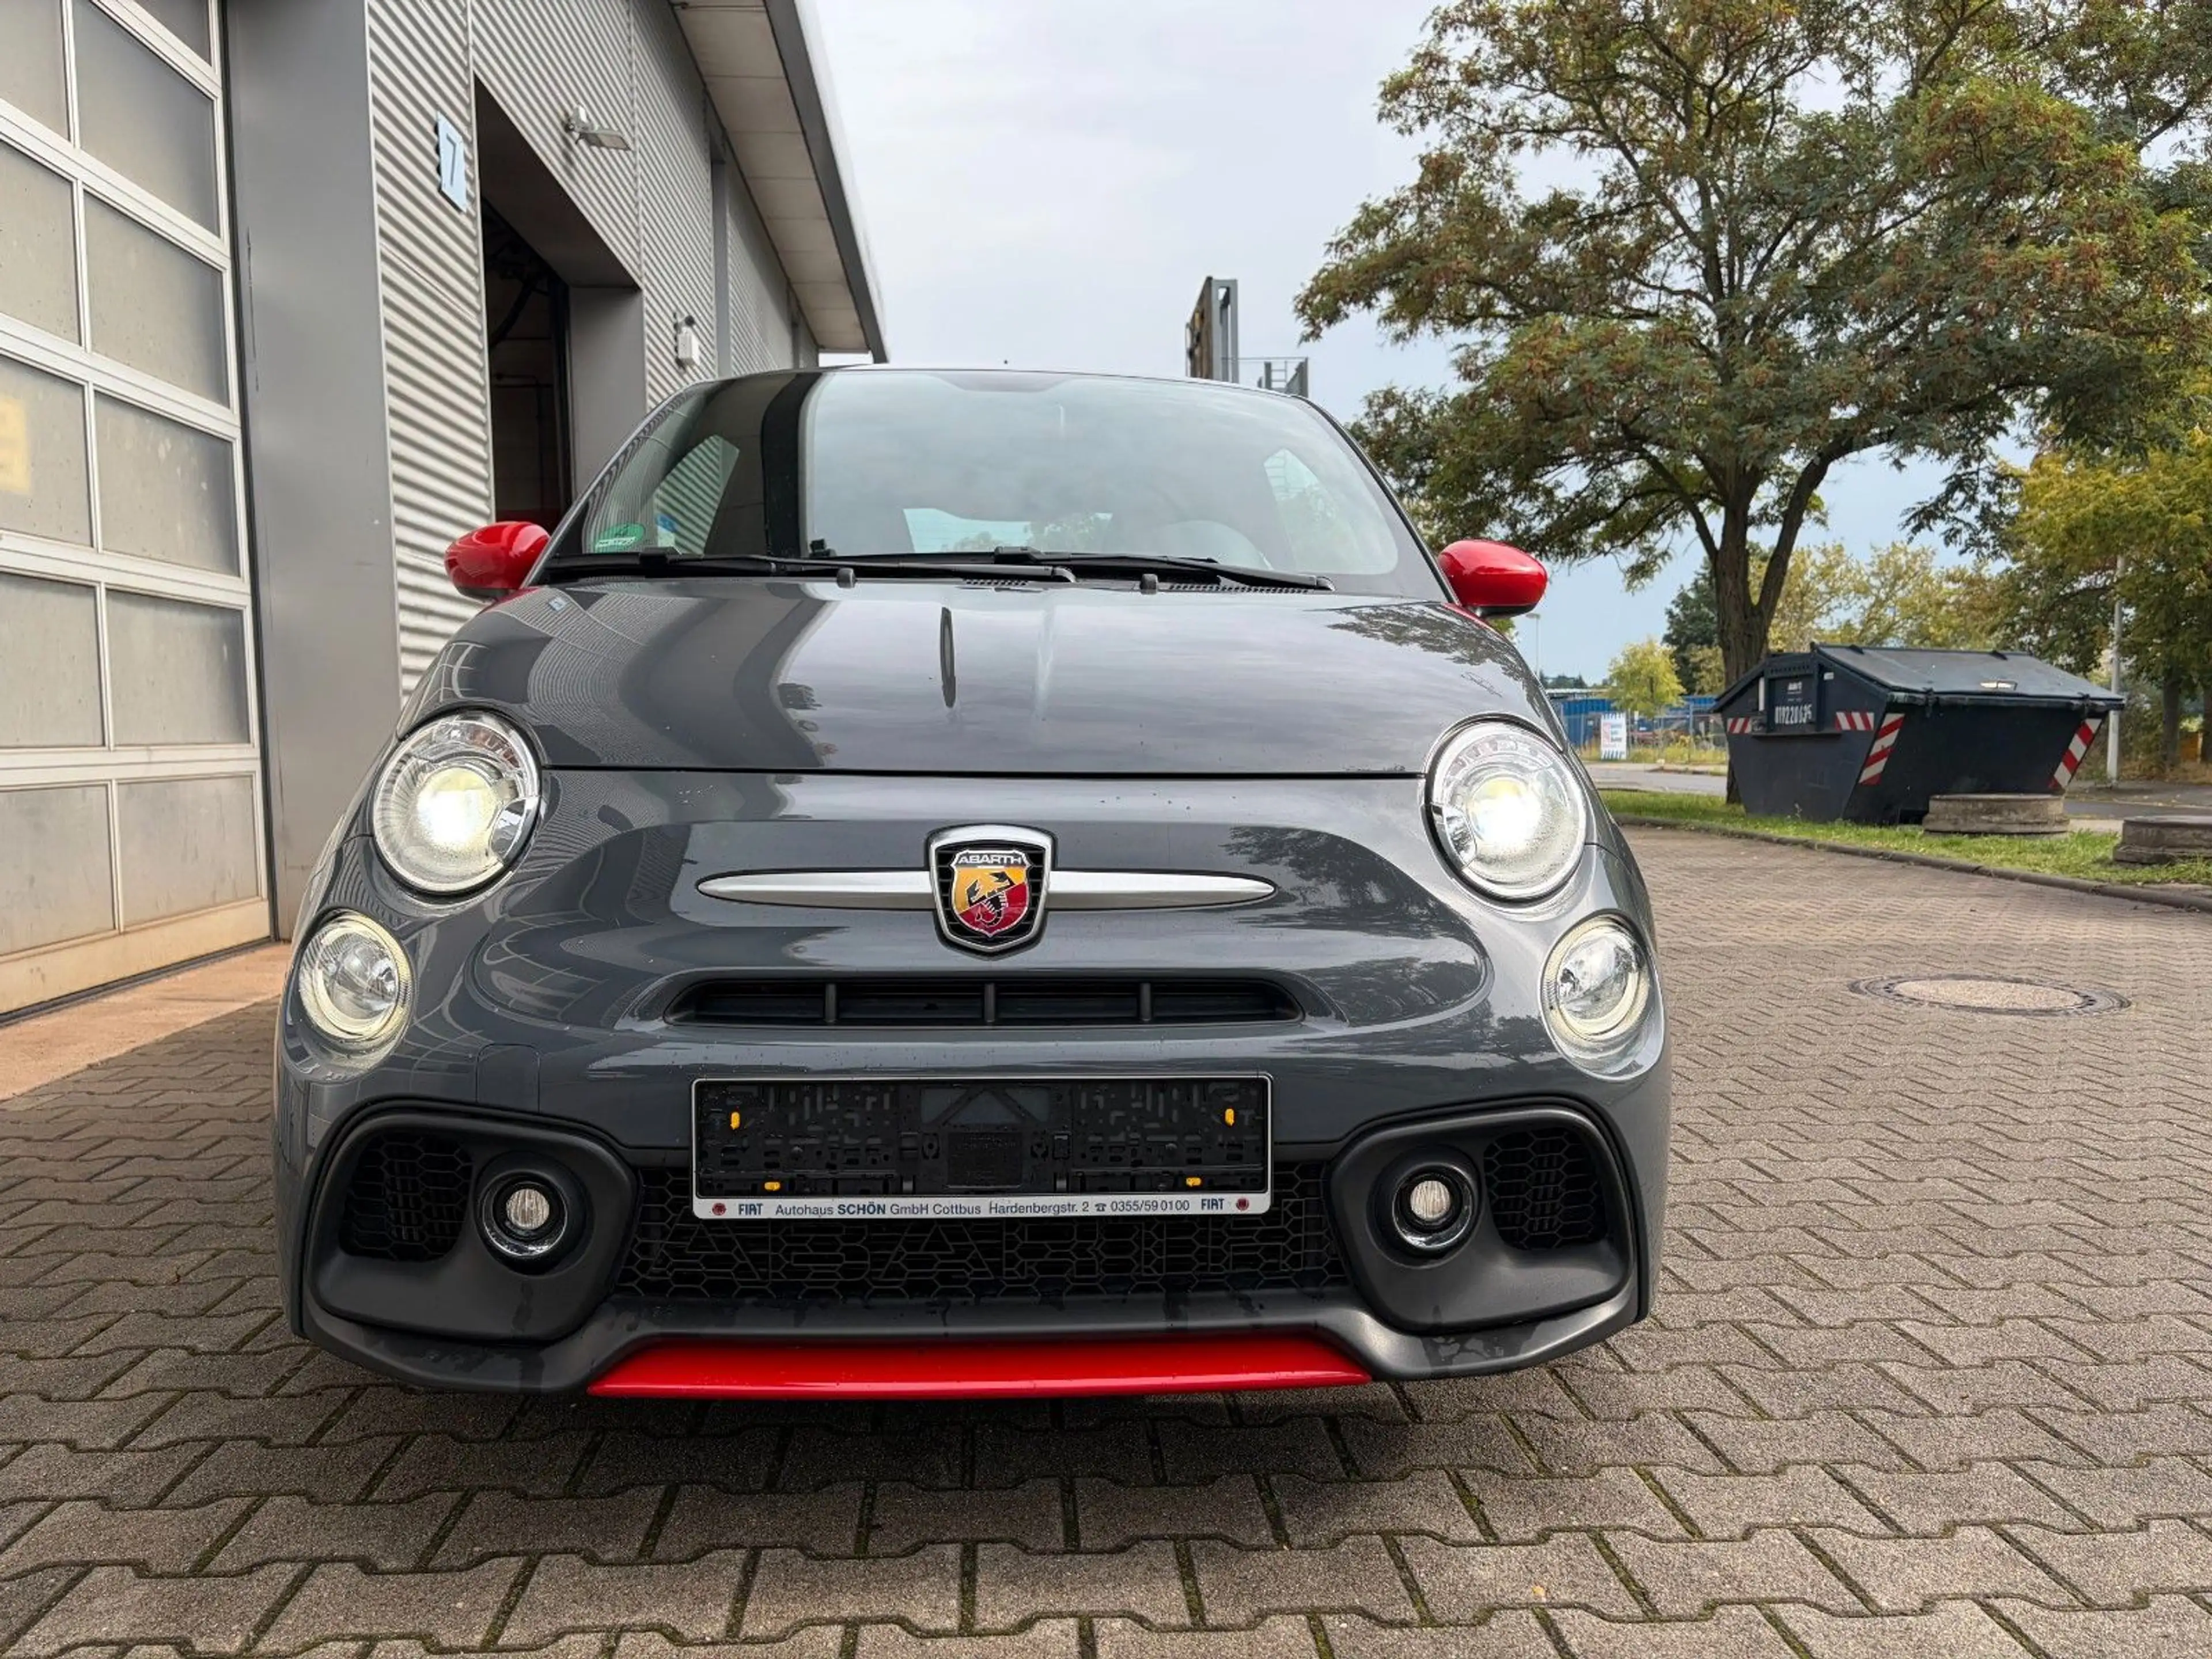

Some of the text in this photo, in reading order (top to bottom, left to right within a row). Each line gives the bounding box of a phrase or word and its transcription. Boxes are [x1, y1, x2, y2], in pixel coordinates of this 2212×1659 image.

[446, 132, 457, 187] 7
[958, 854, 1021, 864] ABARTH
[738, 1203, 763, 1215] FIAT
[775, 1204, 834, 1215] Autohaus
[837, 1201, 886, 1215] SCHÖN
[890, 1203, 929, 1215] GmbH
[933, 1203, 981, 1215] Cottbus
[989, 1201, 1078, 1215] Hardenbergstr.
[1082, 1201, 1089, 1212] 2
[1200, 1198, 1225, 1210] FIAT
